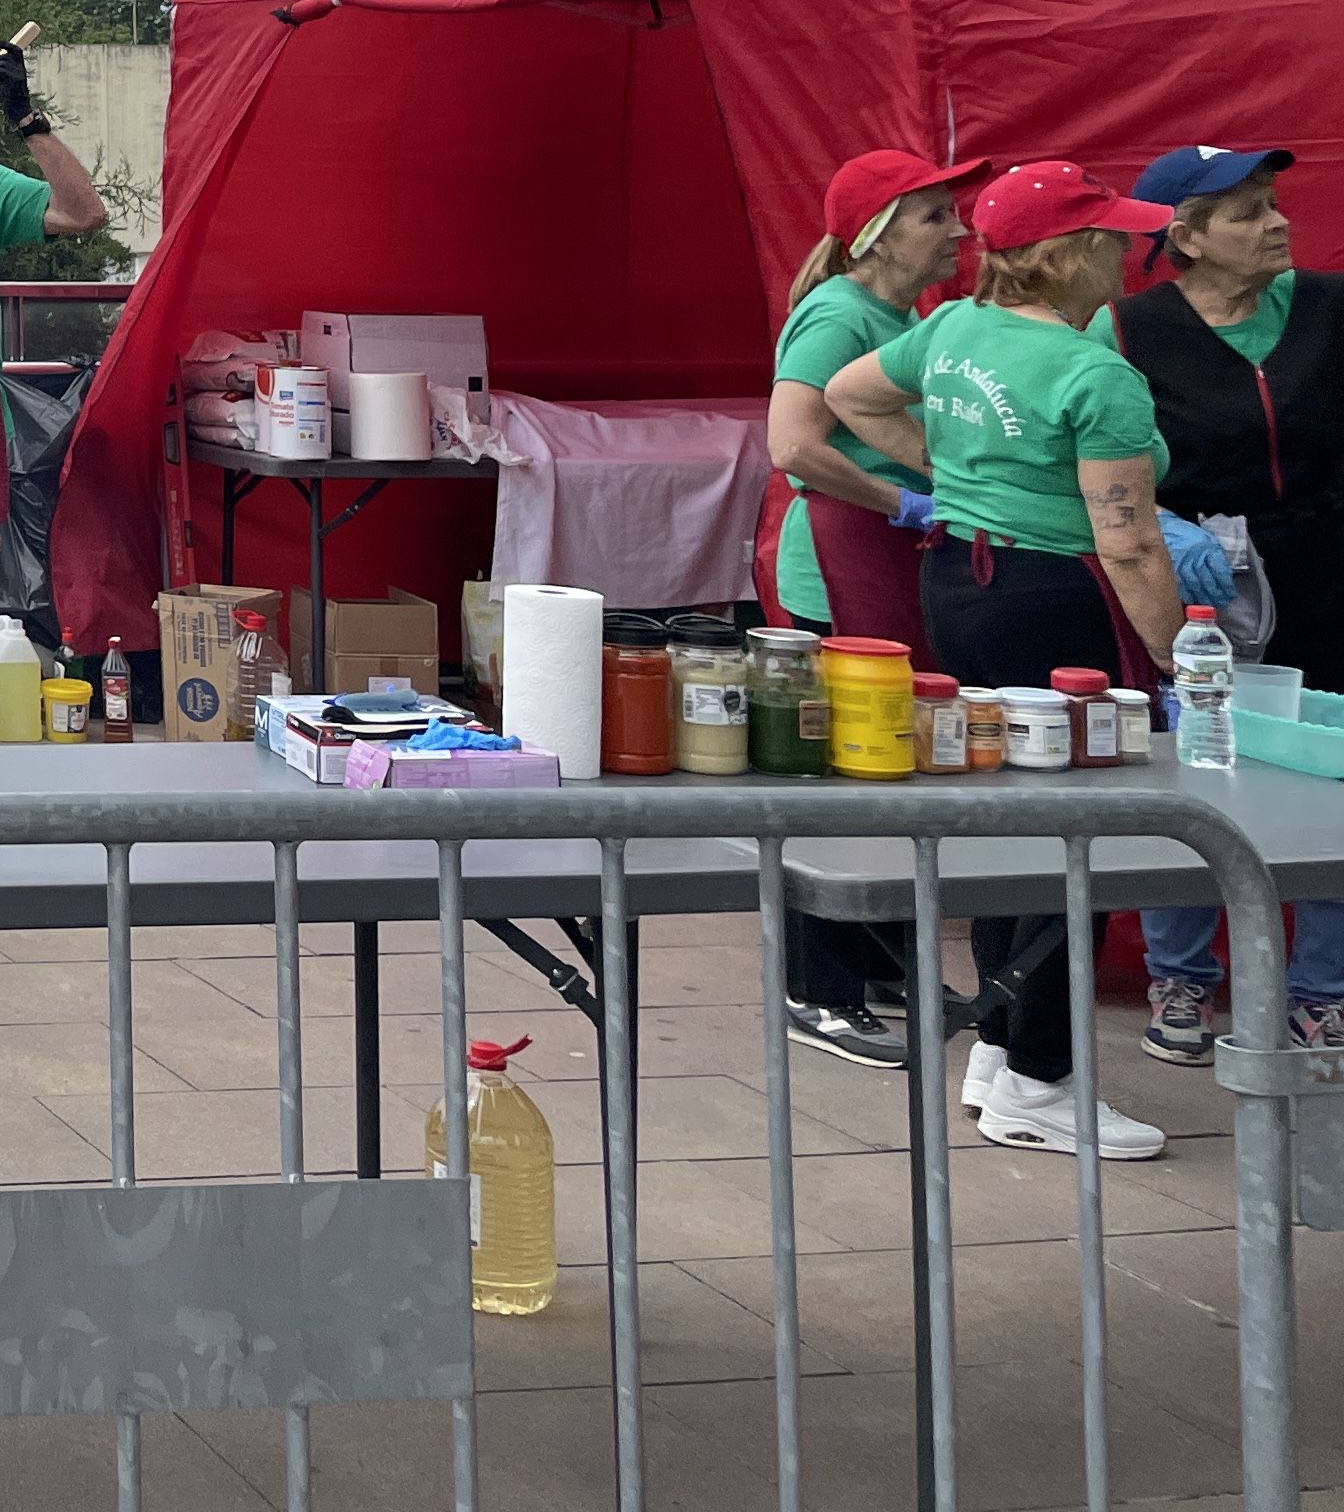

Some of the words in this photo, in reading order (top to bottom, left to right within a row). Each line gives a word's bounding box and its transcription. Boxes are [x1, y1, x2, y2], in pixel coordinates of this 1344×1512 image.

[934, 350, 953, 375] de
[927, 395, 945, 412] en
[255, 705, 268, 730] M
